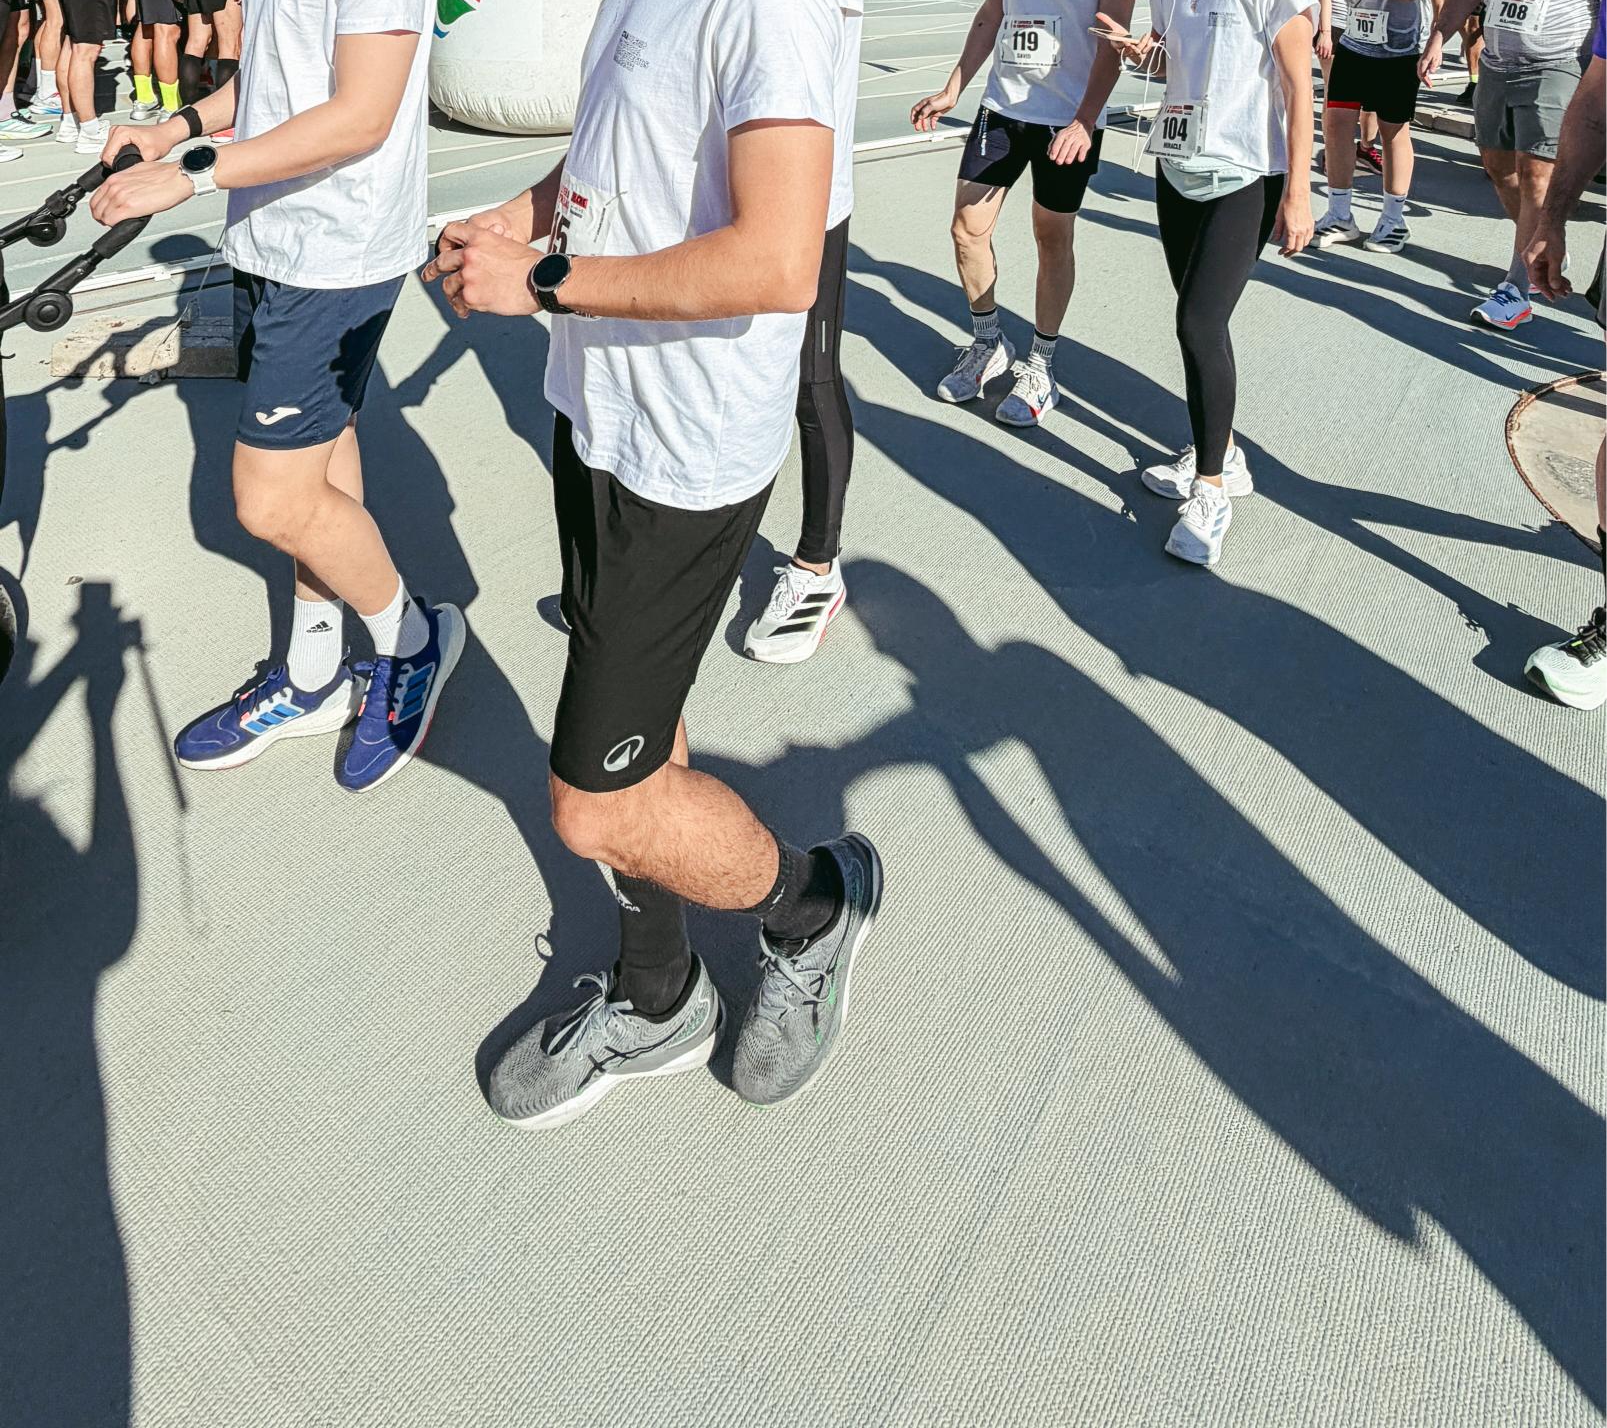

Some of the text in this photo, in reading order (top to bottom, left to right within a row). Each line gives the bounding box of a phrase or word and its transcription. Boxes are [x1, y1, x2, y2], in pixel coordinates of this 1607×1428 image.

[1499, 1, 1529, 21] 708
[1355, 18, 1374, 33] 707
[1012, 30, 1039, 51] 119
[1162, 116, 1188, 142] 104
